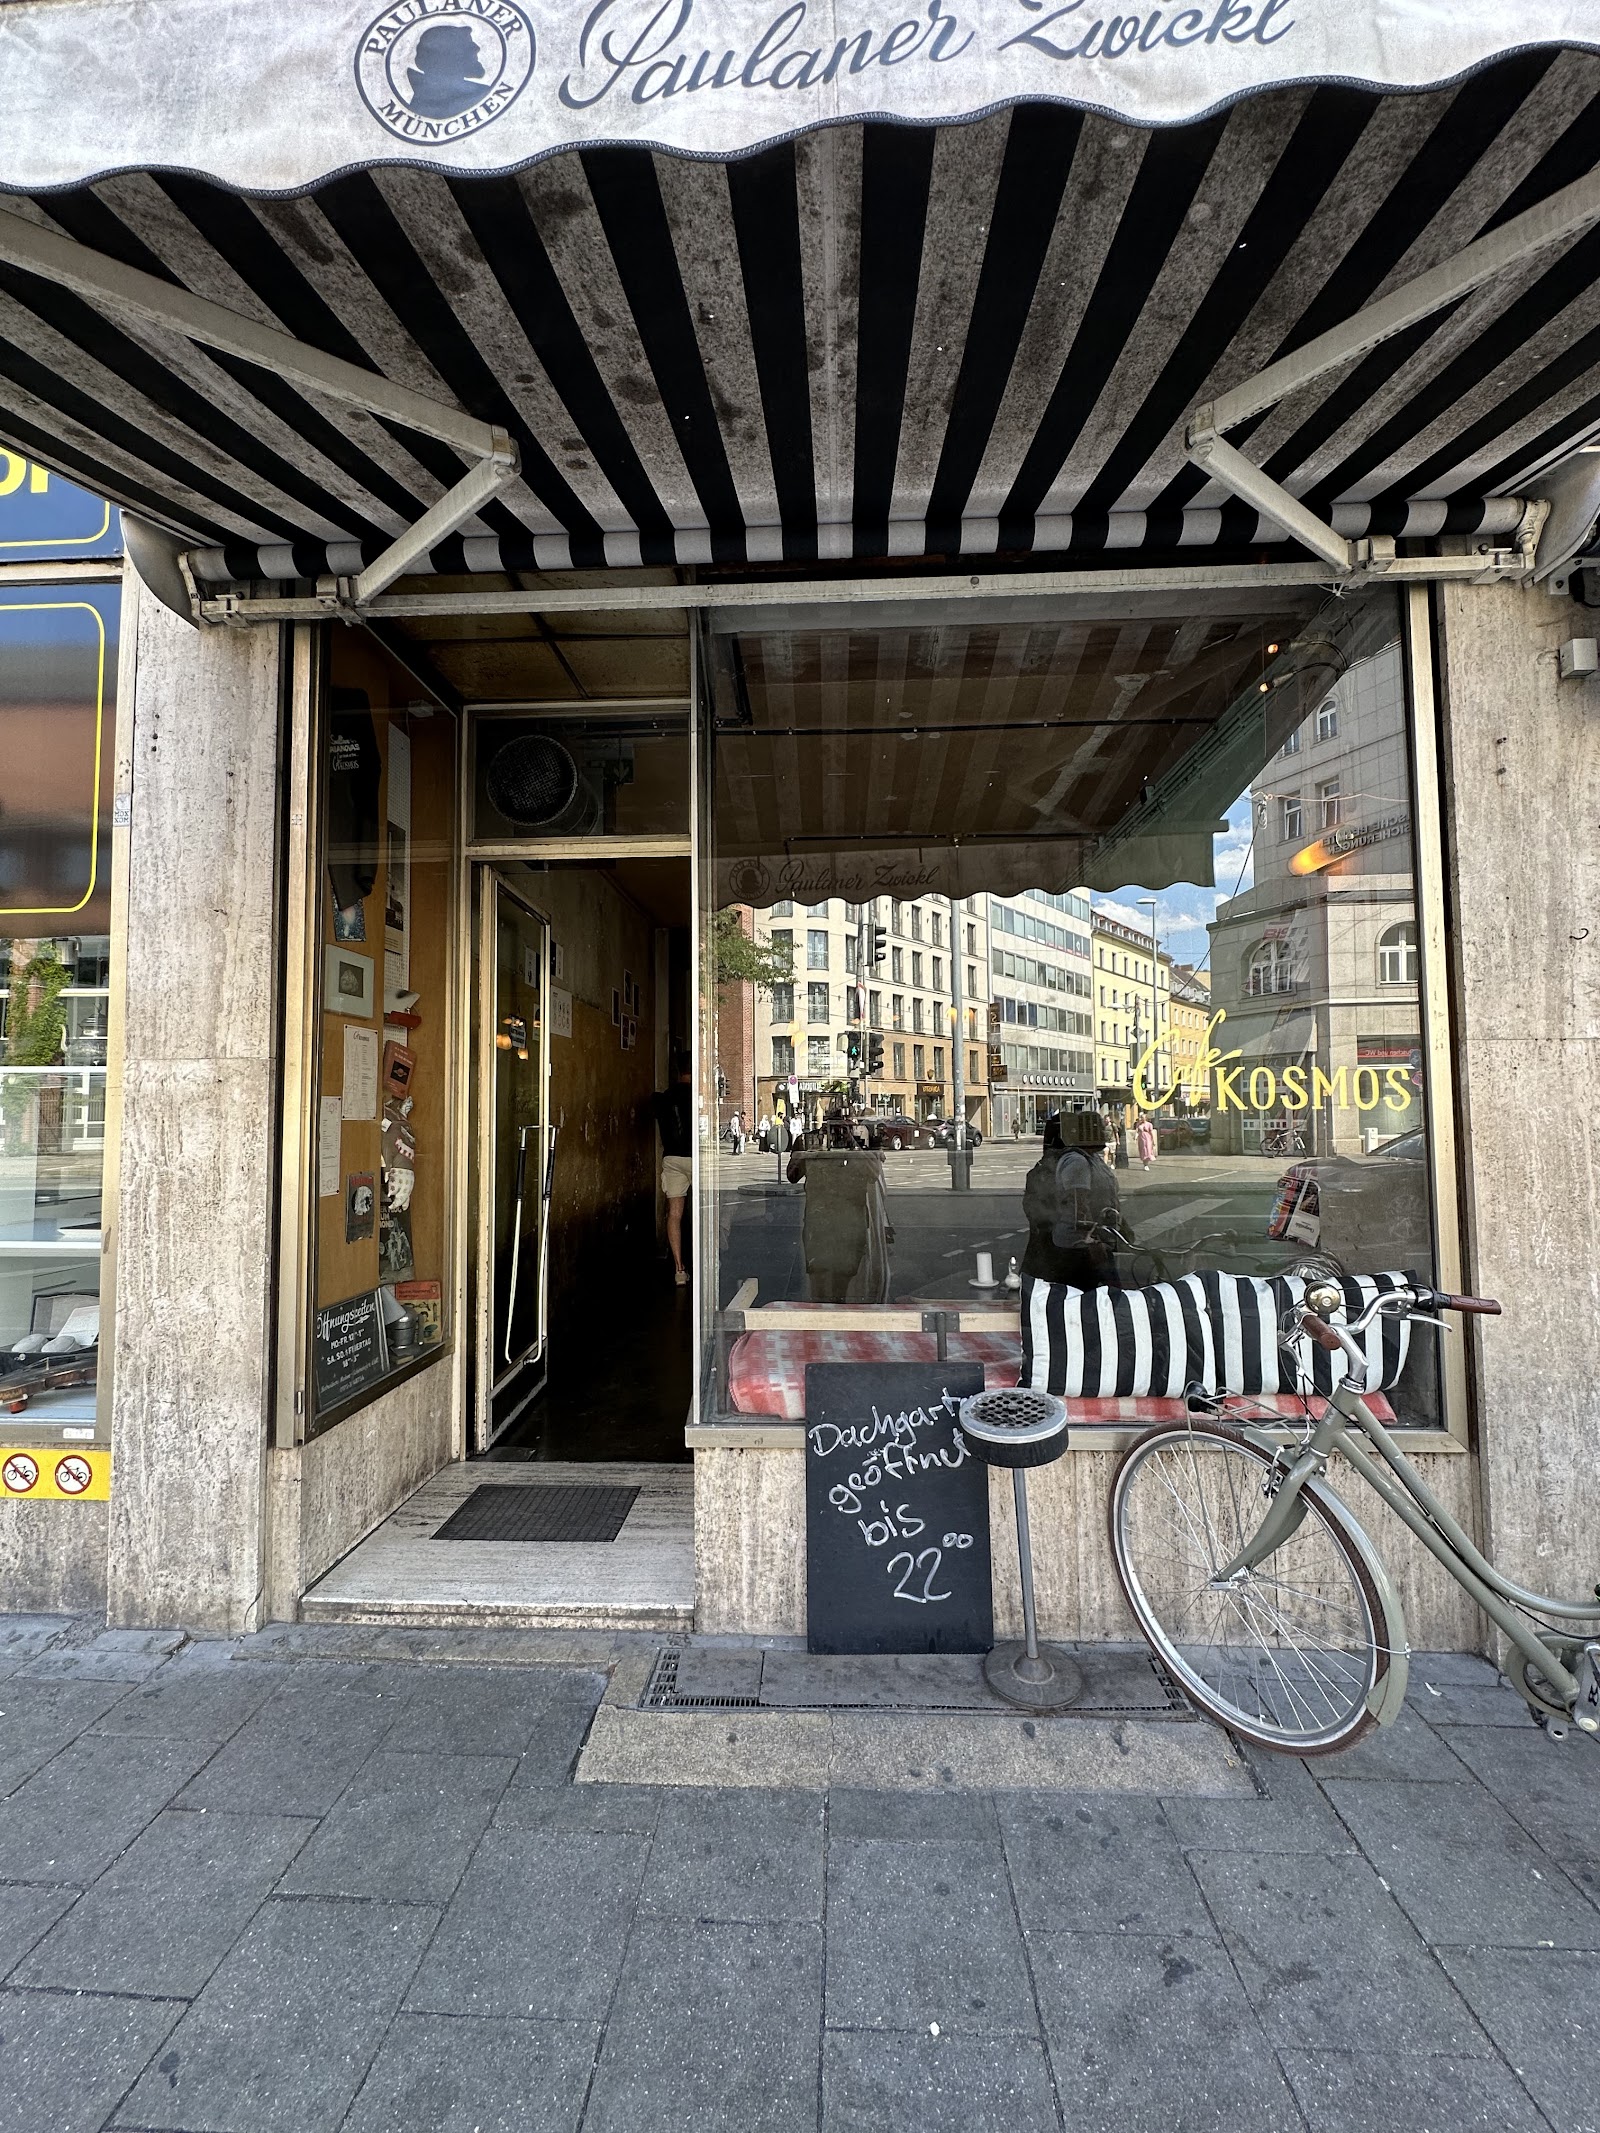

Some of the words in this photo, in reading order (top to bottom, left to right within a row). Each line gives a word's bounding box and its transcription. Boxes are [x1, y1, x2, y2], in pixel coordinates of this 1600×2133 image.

[364, 0, 523, 56] PAULANER
[558, 0, 974, 110] Paulaner
[997, 0, 1296, 61] Zwickl
[378, 81, 515, 139] MÜNCHEN
[774, 858, 865, 894] Paulaner
[870, 863, 940, 888] Zwickl
[1214, 1064, 1412, 1113] KOSMOS
[316, 1299, 376, 1341] Öffnungszeiten
[808, 1387, 973, 1456] Dachgart
[828, 1427, 972, 1514] geöffnet
[857, 1499, 926, 1547] bis
